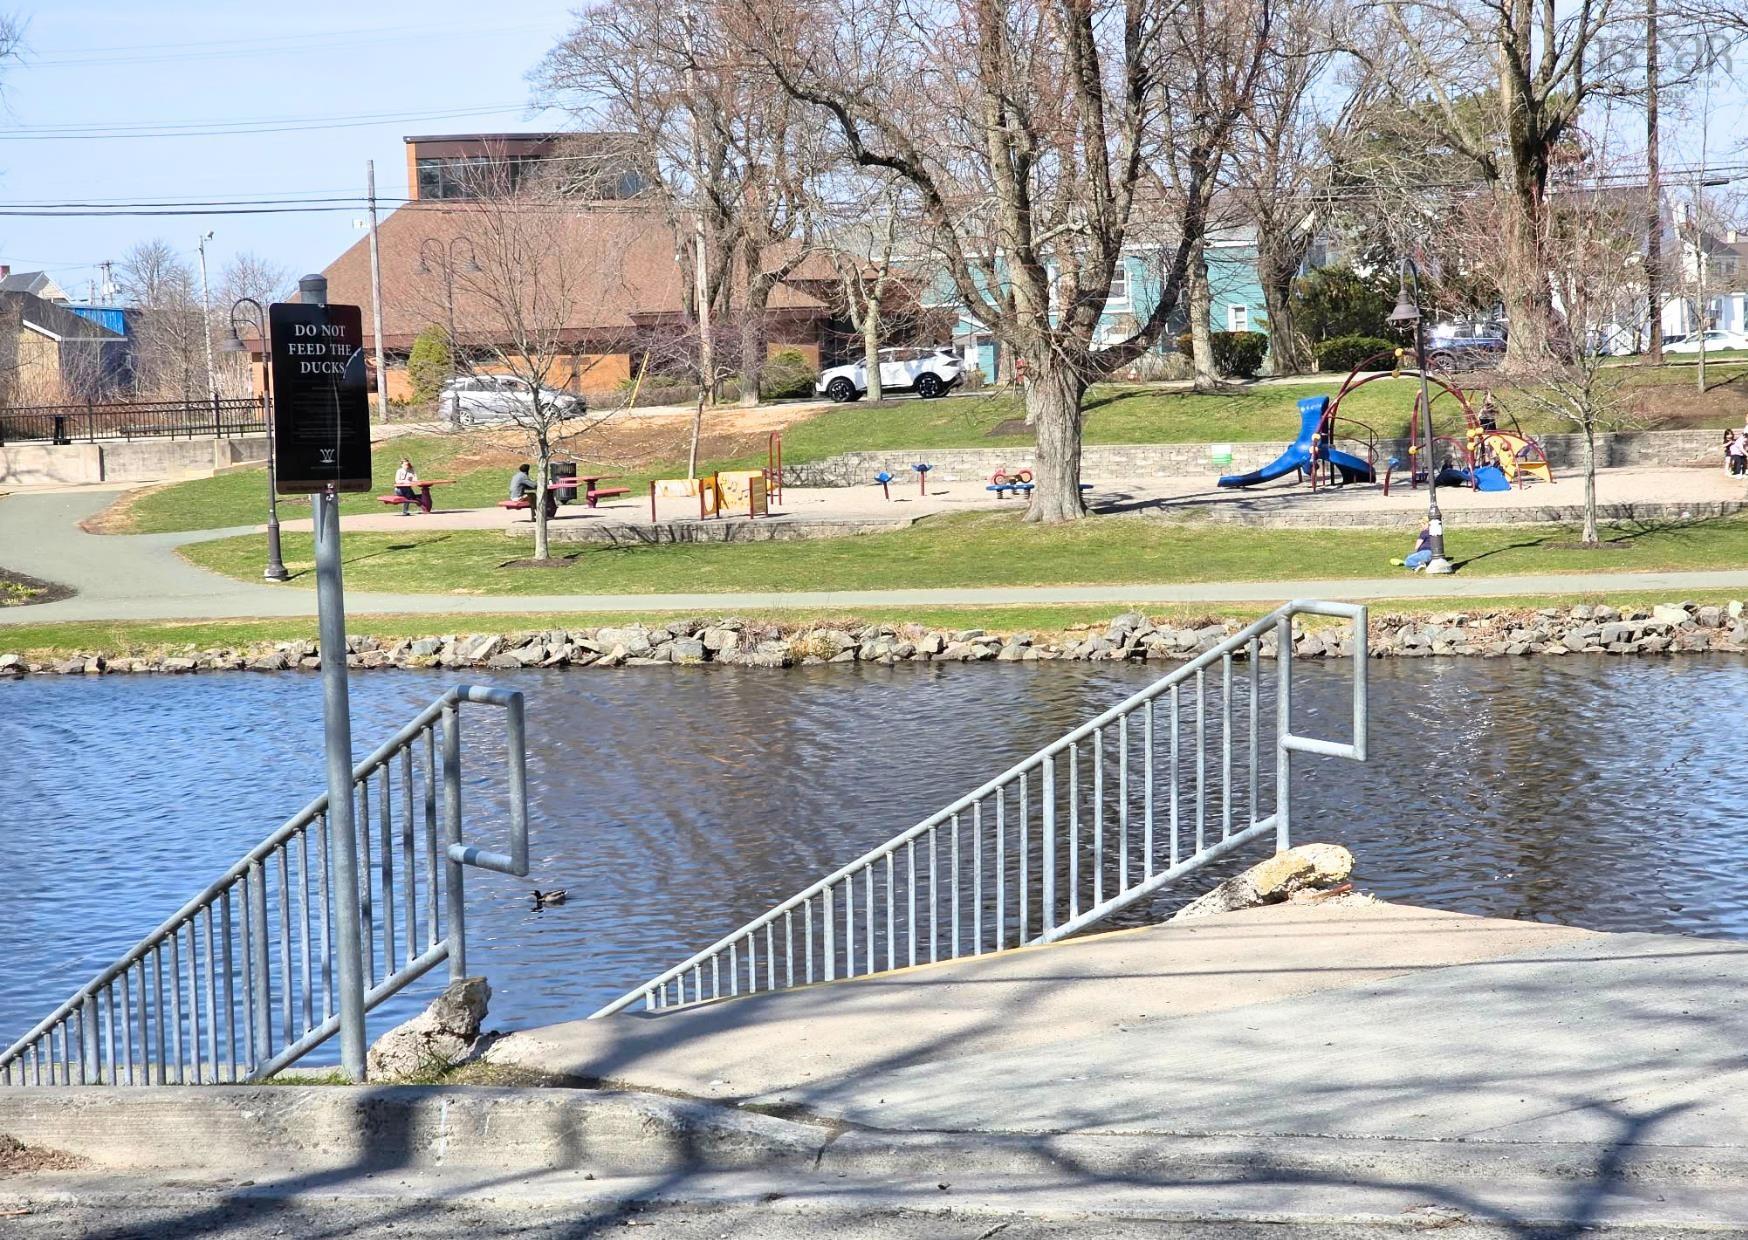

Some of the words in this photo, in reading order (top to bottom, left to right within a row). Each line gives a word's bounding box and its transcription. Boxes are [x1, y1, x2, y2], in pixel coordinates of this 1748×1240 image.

[294, 324, 317, 337] DO
[321, 325, 346, 337] NOT
[288, 343, 326, 355] FEED
[329, 344, 352, 356] THE
[300, 361, 345, 374] DUCKS
